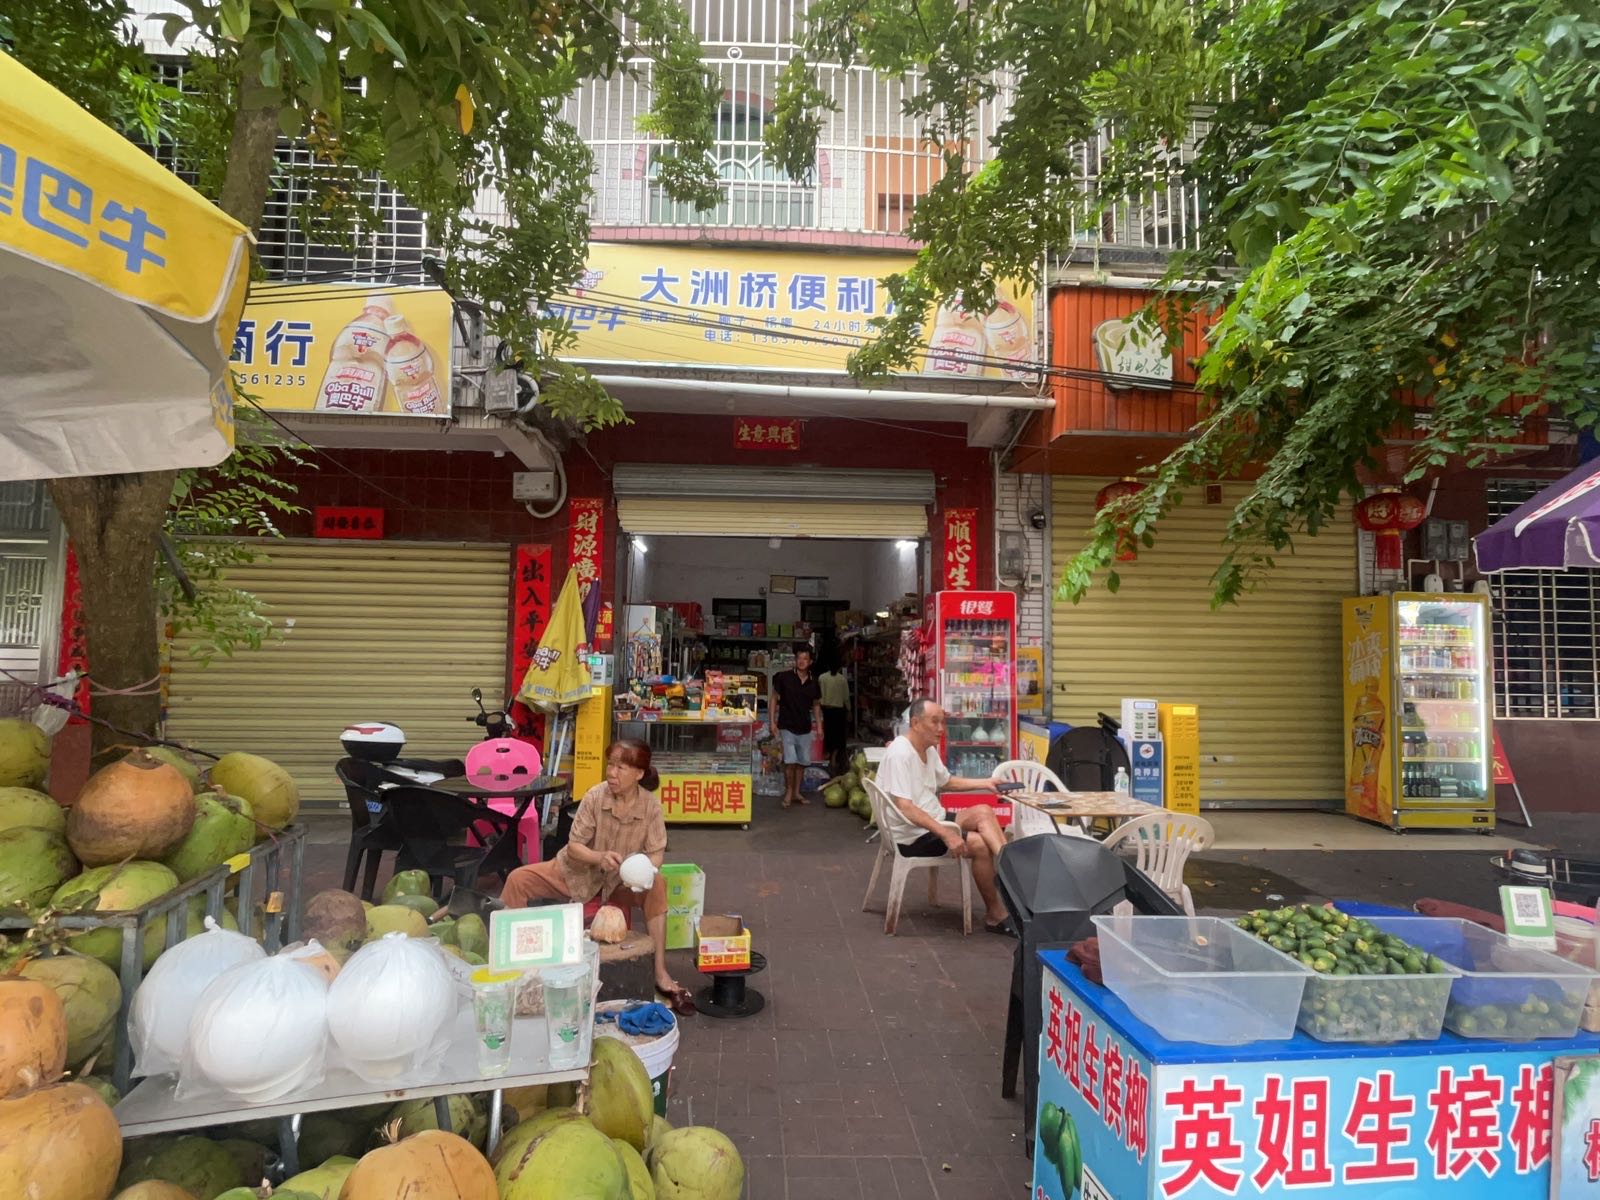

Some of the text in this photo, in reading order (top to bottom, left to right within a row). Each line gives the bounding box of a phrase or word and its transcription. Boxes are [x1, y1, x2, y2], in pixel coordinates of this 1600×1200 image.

[640, 267, 902, 315] 大洲桥便利
[327, 382, 375, 399] Oba Bull
[660, 779, 746, 814] 中国烟草
[1046, 984, 1149, 1164] 英姐生槟榔
